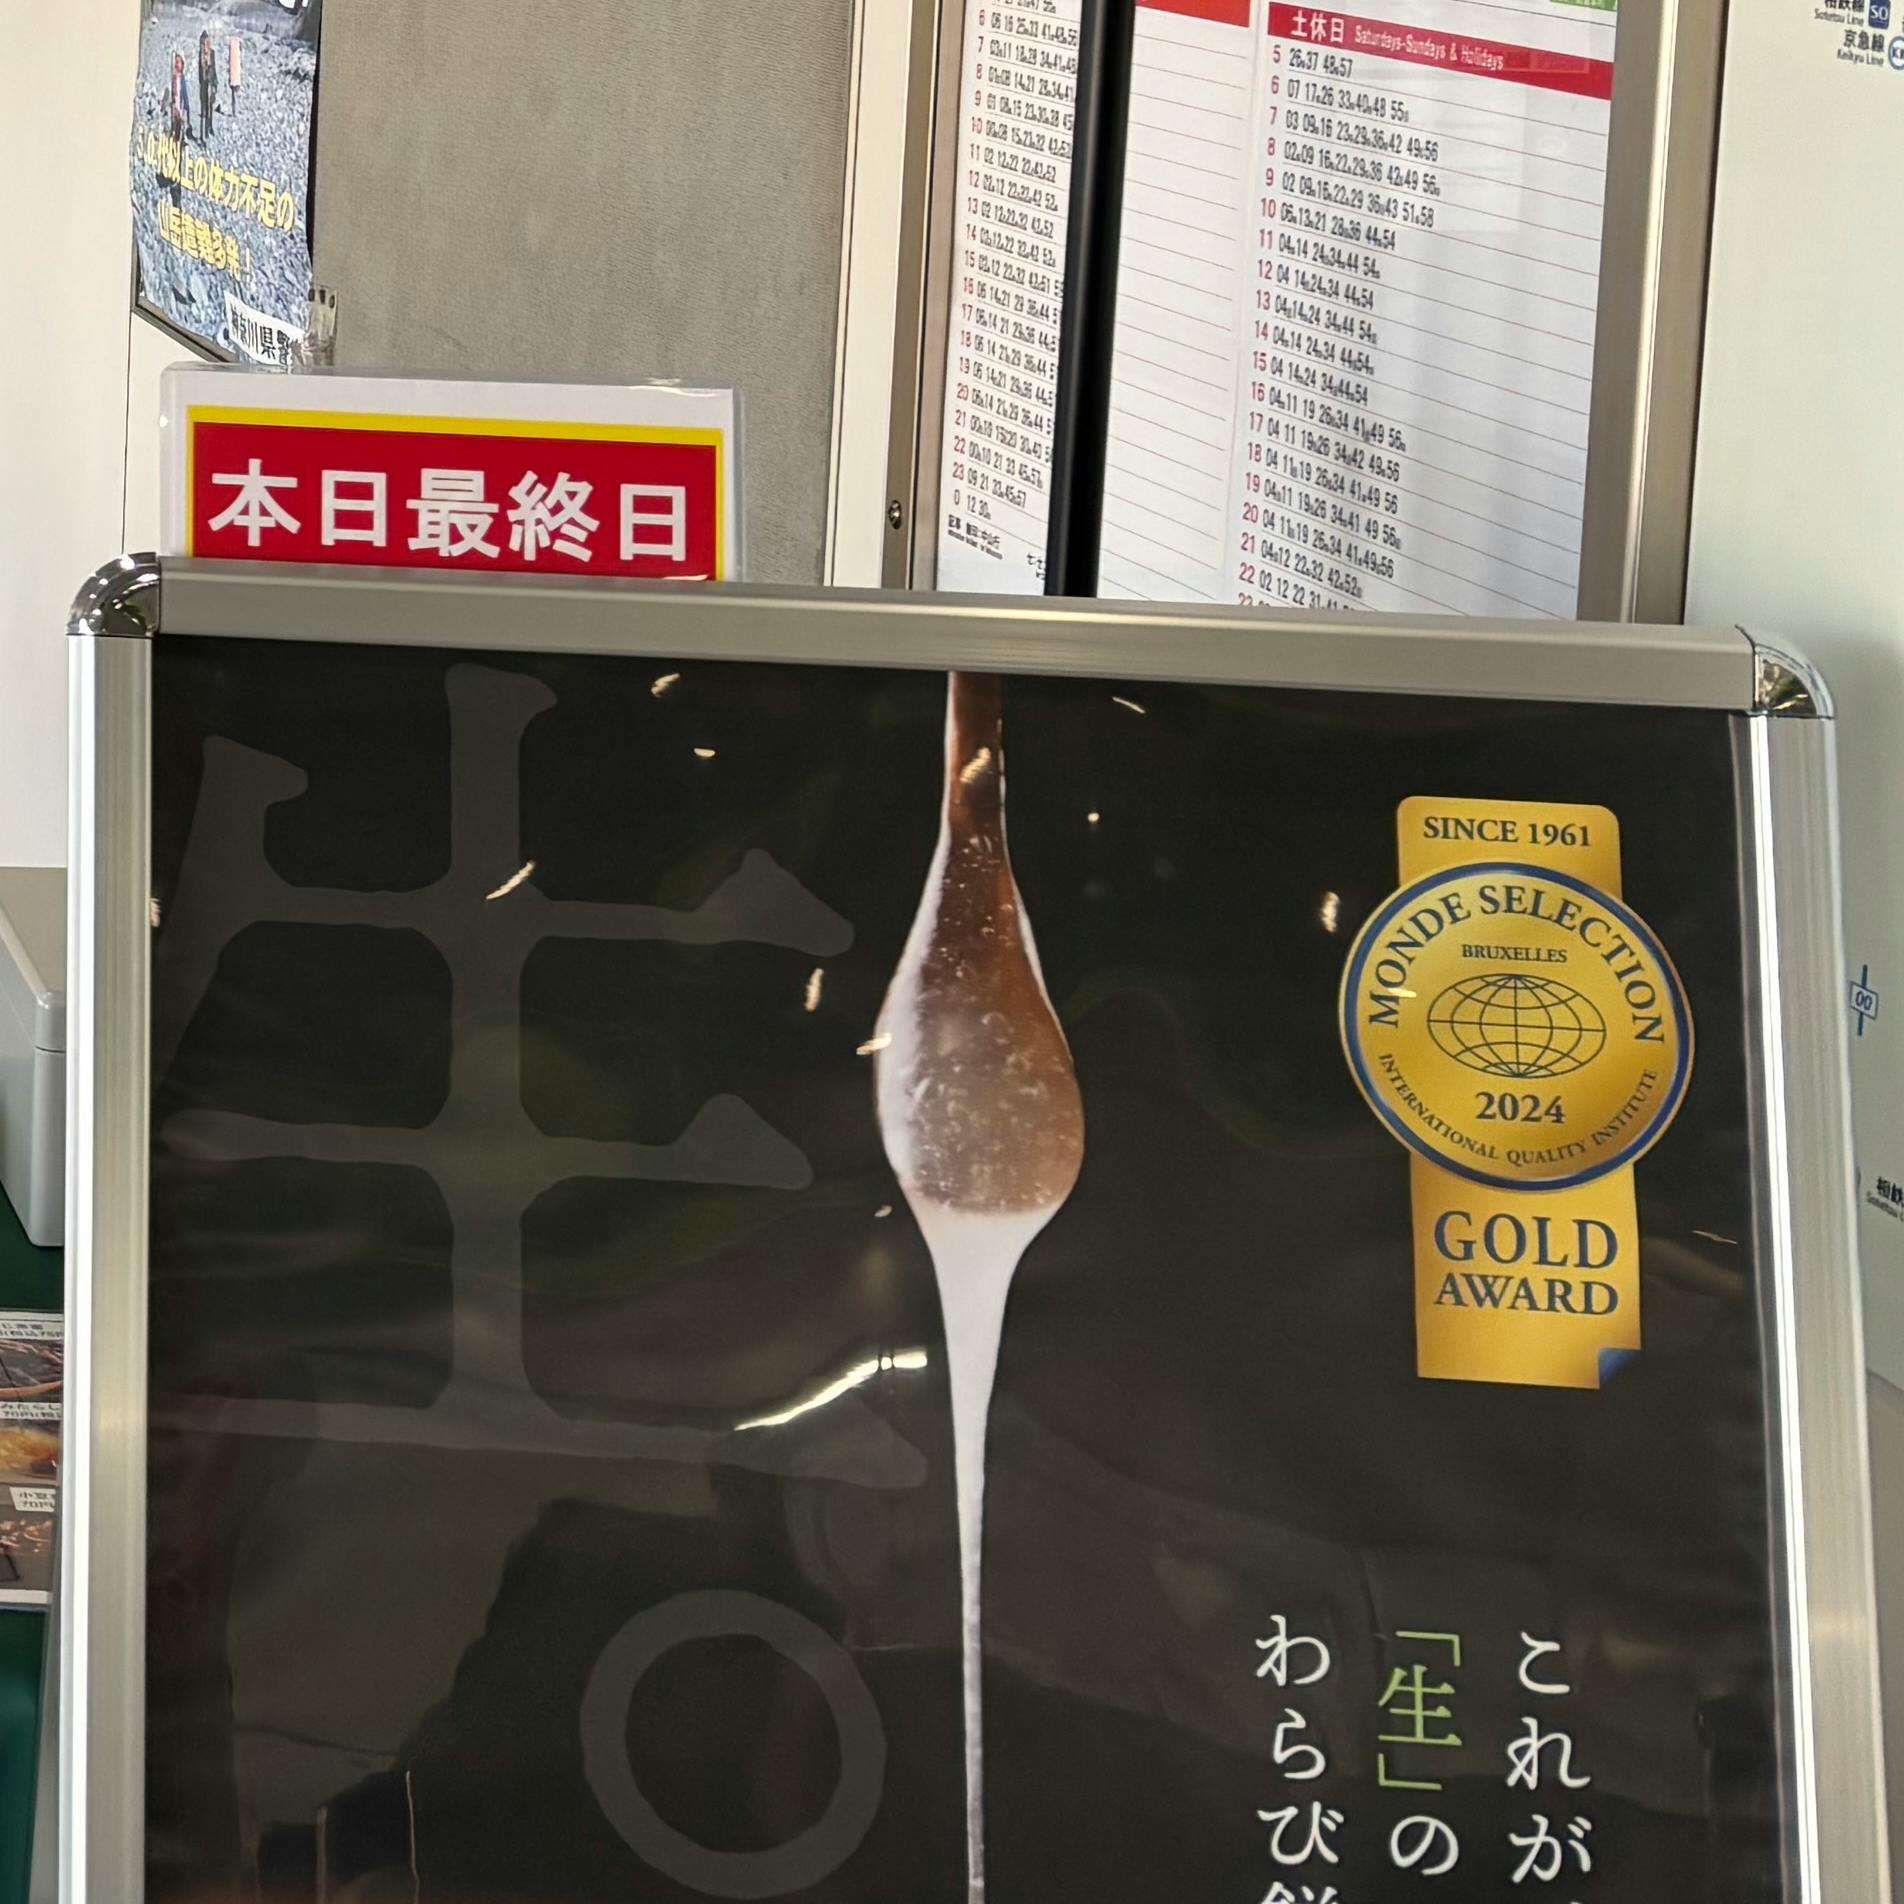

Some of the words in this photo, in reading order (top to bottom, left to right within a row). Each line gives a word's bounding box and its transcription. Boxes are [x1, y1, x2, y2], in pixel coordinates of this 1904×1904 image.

[1291, 10, 1345, 43] 土休日
[1844, 30, 1885, 53] 京急線
[1272, 45, 1281, 64] 5
[208, 457, 689, 566] 本日最終日
[1423, 817, 1519, 843] SINCE
[1529, 823, 1591, 847] 1961
[1368, 893, 1471, 1029] MONDE
[1480, 885, 1665, 1044] SELECTION
[1461, 944, 1567, 964] BRUXELLES
[1378, 1053, 1500, 1159] INTERNATIONAL
[1507, 1139, 1588, 1166] QUALITY
[1593, 1068, 1656, 1147] INSTITUTE
[1475, 1090, 1566, 1125] 2024
[1434, 1209, 1618, 1270] GOLD
[1434, 1273, 1619, 1315] AWARD
[1255, 1615, 1345, 1904] わらび
[1378, 1631, 1462, 1875] 「生」の
[1507, 1631, 1592, 1883] これが
